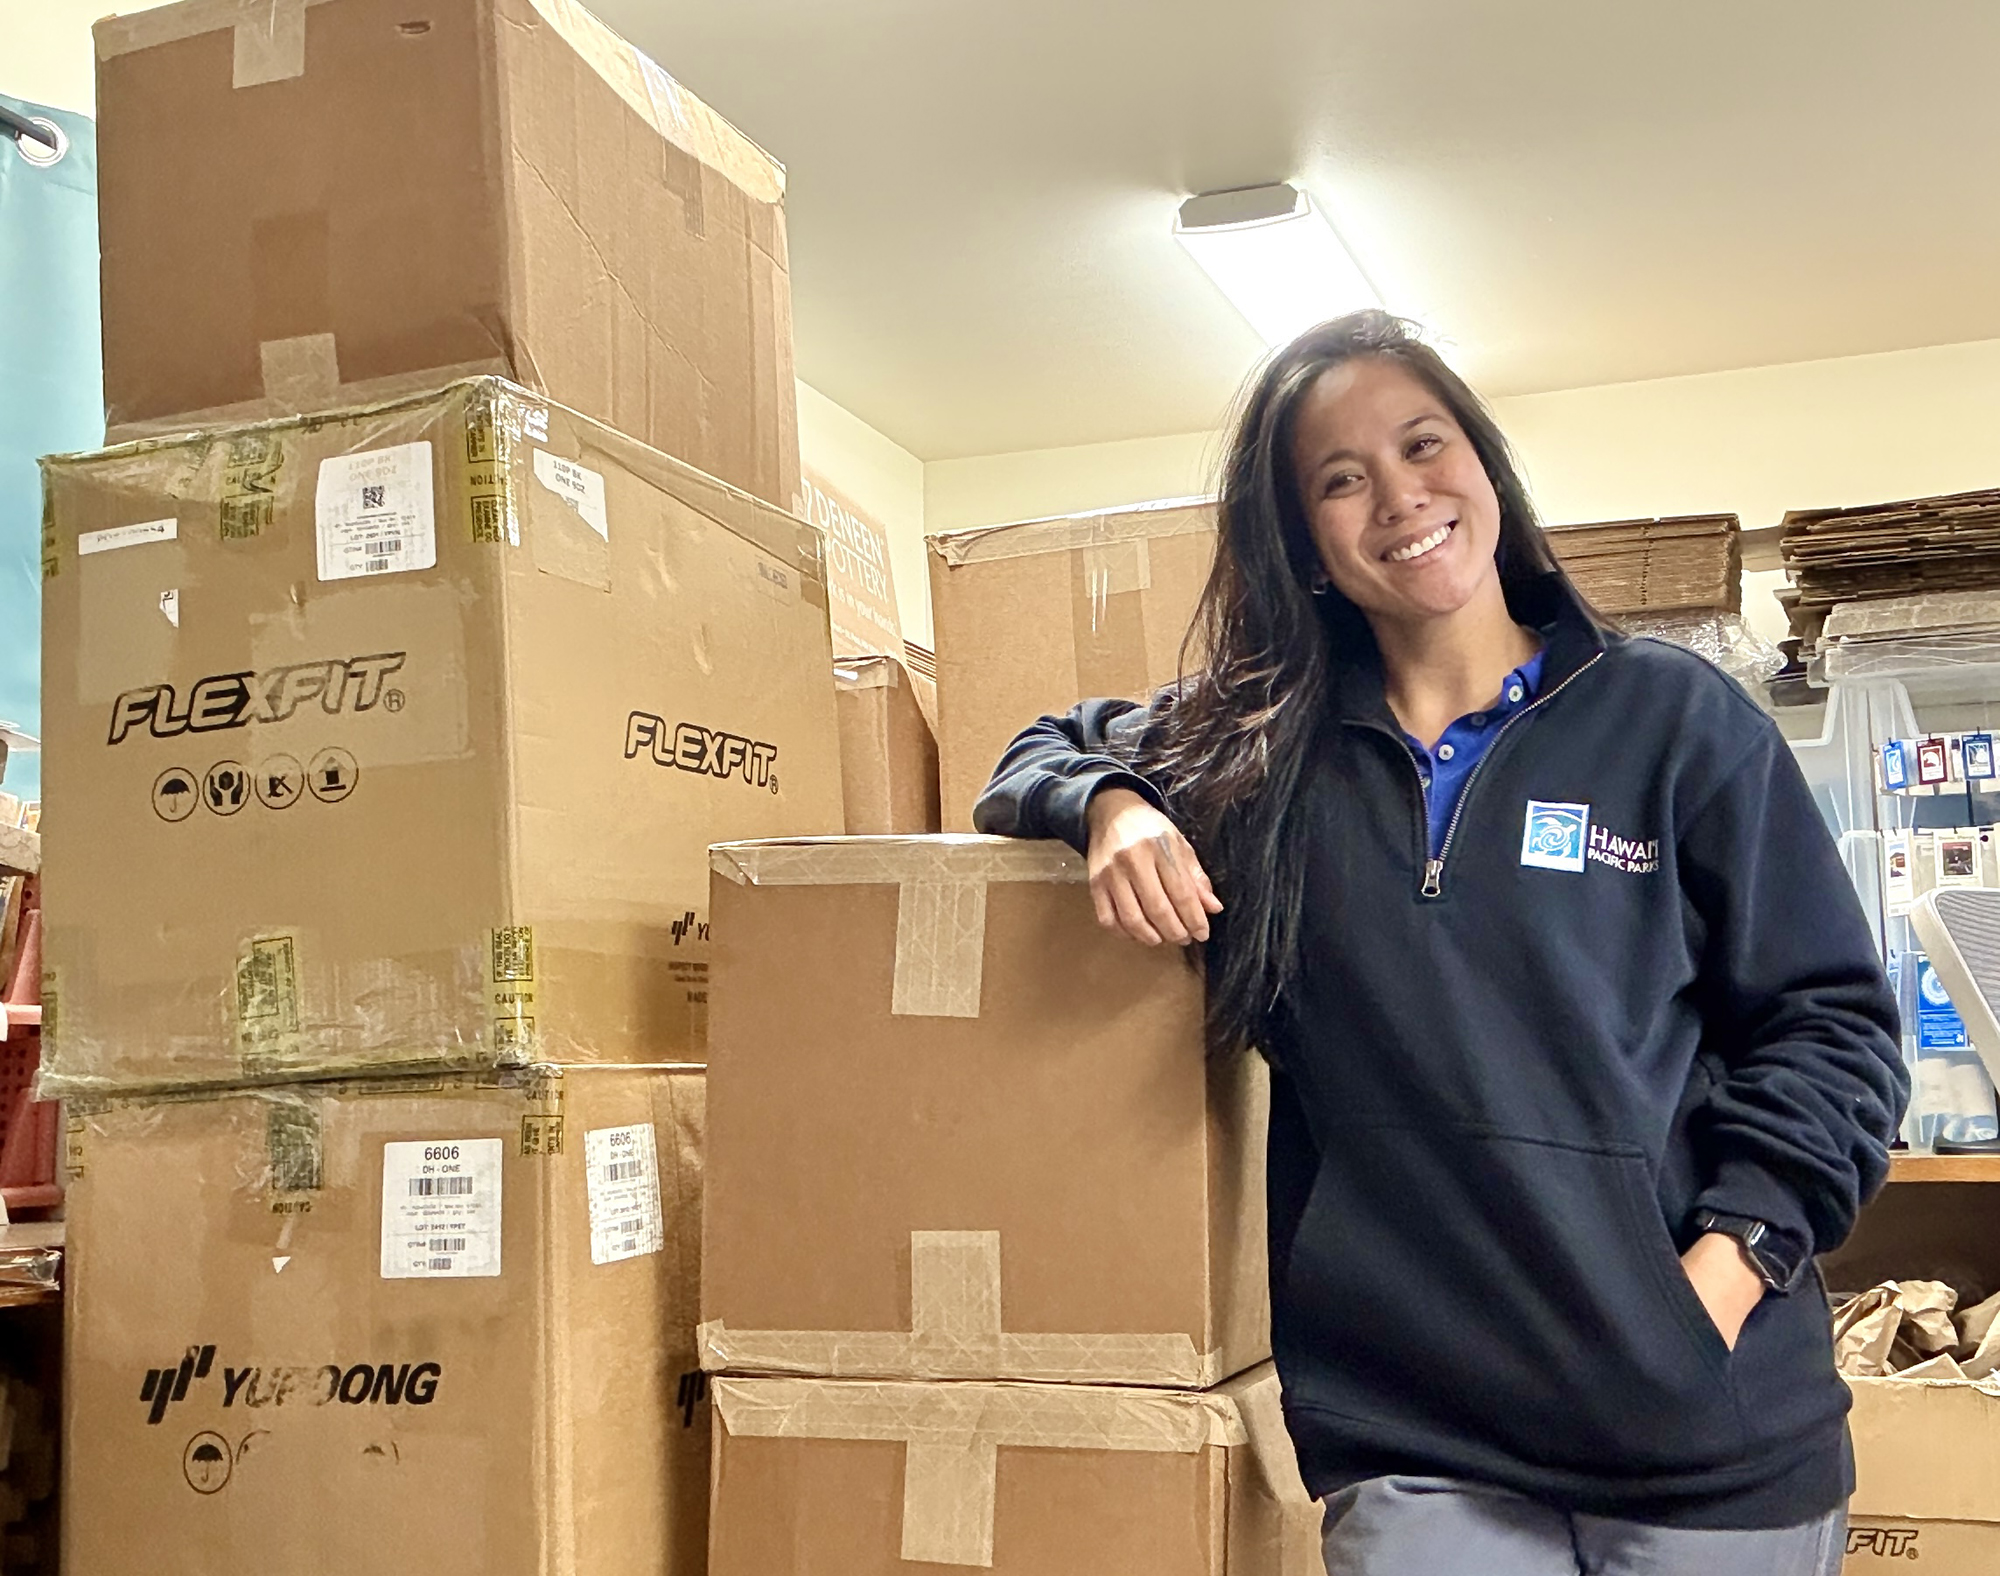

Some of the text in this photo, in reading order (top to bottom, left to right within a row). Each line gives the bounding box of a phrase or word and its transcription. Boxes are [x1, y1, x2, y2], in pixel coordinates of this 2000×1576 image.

[555, 473, 570, 487] ONE
[813, 486, 885, 569] DENEEN
[1587, 847, 1660, 873] PACIFIC PARKS
[610, 1132, 632, 1147] 6606
[424, 1146, 460, 1160] 6606
[441, 1164, 461, 1173] ONE
